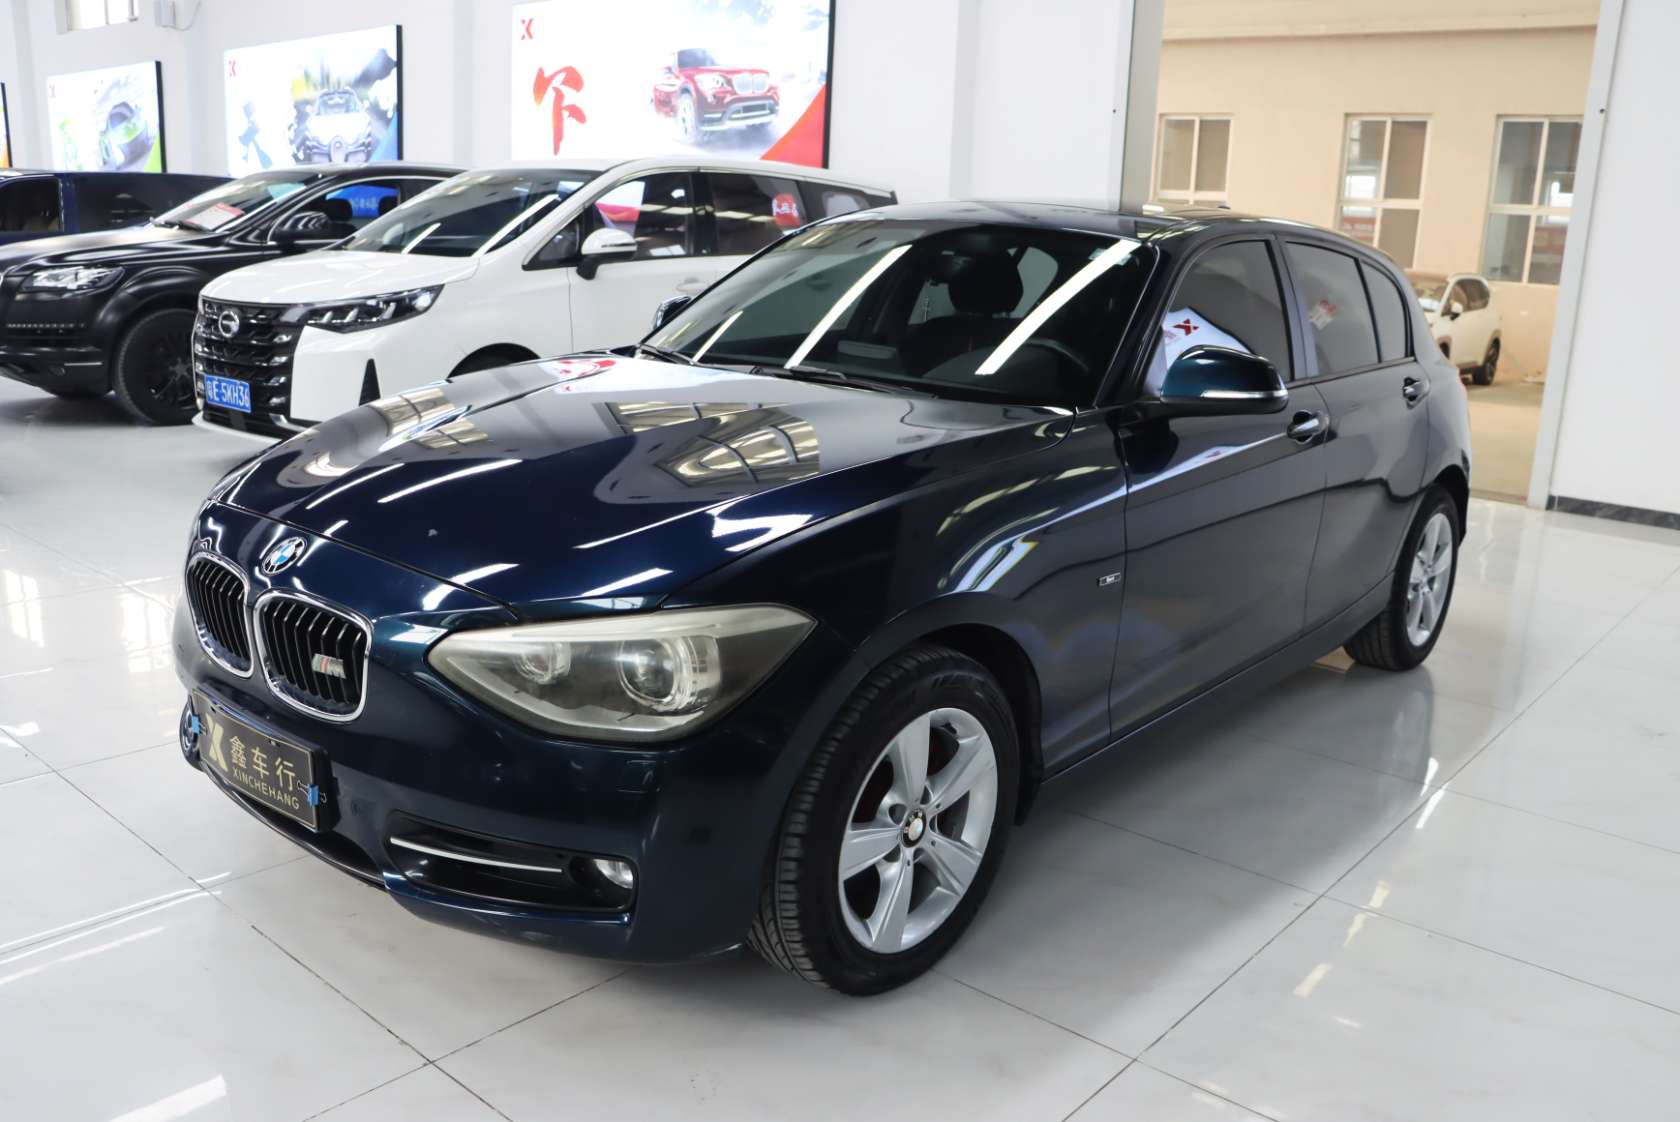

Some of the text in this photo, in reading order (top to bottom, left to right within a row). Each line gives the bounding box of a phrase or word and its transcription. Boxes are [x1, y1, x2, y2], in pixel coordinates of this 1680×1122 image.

[230, 735, 296, 791] 鑫车行
[232, 766, 300, 810] XINCHEHANG
